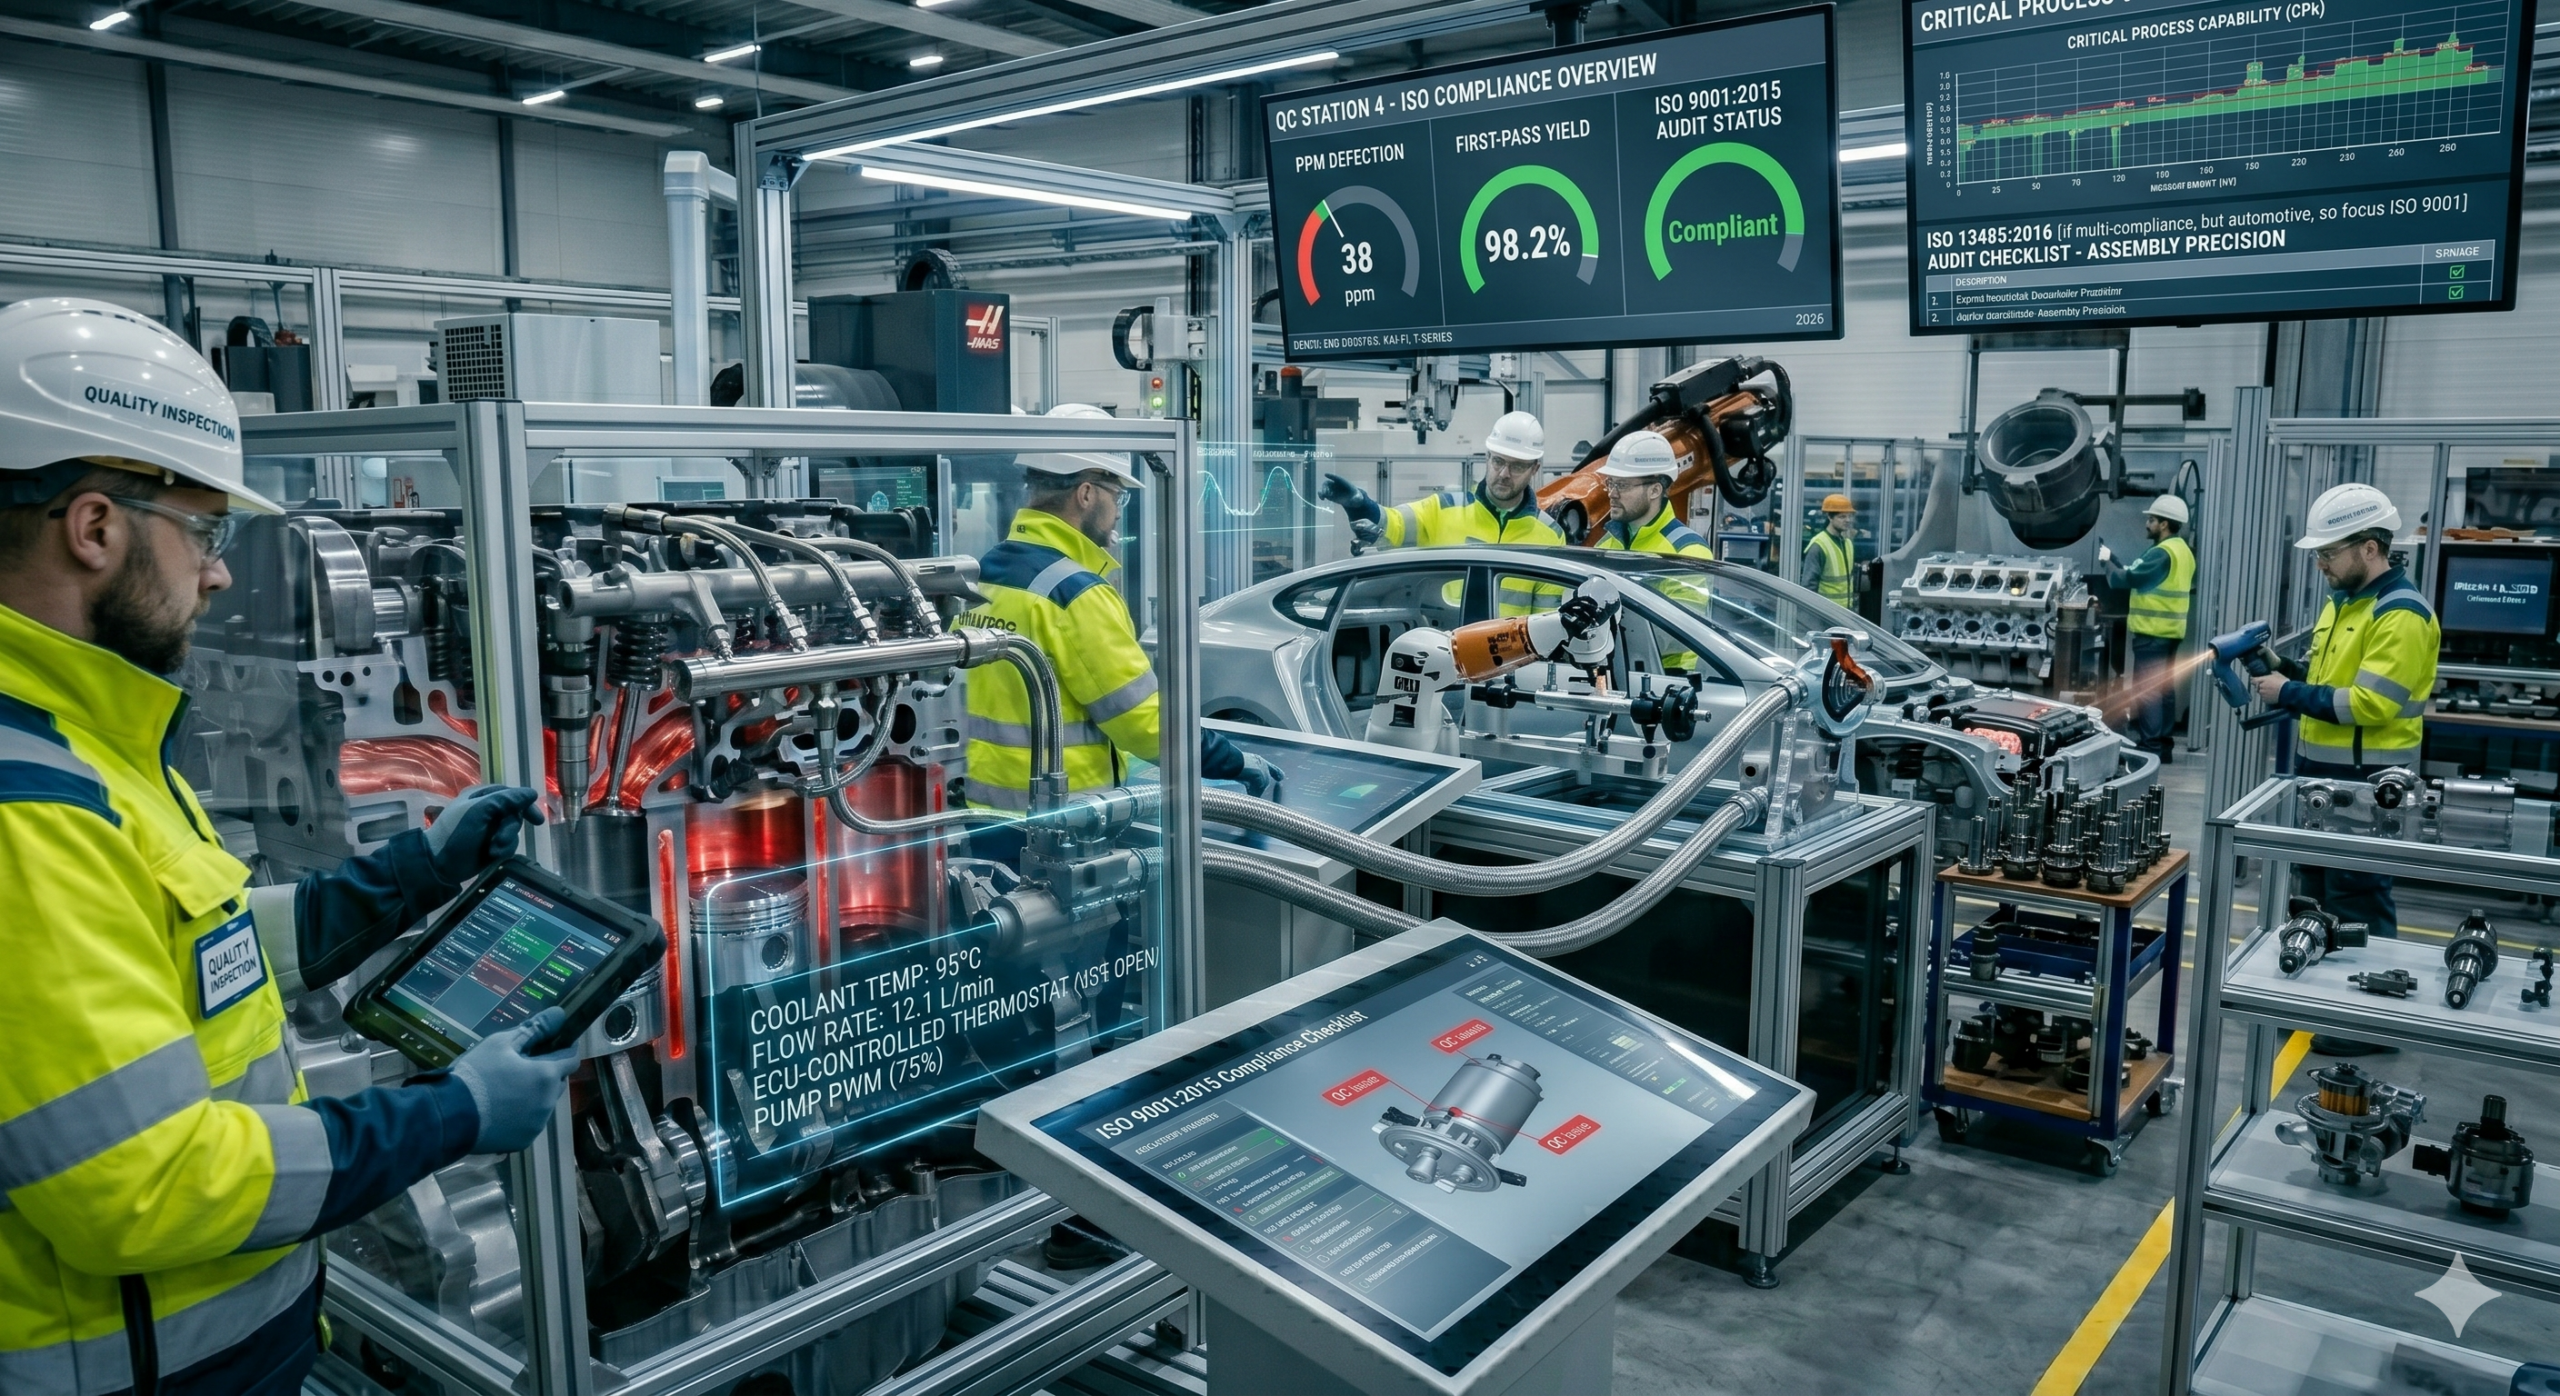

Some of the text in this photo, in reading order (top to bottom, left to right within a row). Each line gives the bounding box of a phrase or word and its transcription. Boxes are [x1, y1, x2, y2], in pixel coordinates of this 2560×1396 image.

[1920, 0, 2012, 32] CRITICAL
[2067, 30, 2128, 50] CRITICAL
[2131, 19, 2195, 42] PROCESS
[2199, 6, 2282, 32] CAPABILITY
[1276, 109, 1297, 132] QC
[1301, 95, 1370, 127] STATION
[1373, 95, 1385, 116] 4
[1401, 88, 1430, 112] ISO
[1434, 68, 1553, 108] COMPLIANCE
[1557, 53, 1658, 88] OVERVIEW
[1655, 79, 1782, 115] ISO 9001:2015
[1455, 119, 1591, 154] FIRST-PASS YIELD
[1656, 105, 1782, 140] AUDIT STATUS
[1295, 142, 1405, 173] PPM DEFECTION
[1668, 212, 1779, 247] Compliant
[1926, 231, 1954, 249] ISO
[1958, 223, 2052, 247] 13485:2016
[2075, 213, 2198, 239] multi-compliance,
[2201, 213, 2225, 230] but
[2228, 206, 2315, 228] automotive,
[2319, 206, 2338, 221] so
[2341, 202, 2385, 219] focus
[2389, 198, 2417, 216] ISO
[2421, 193, 2469, 213] 9001]
[1341, 241, 1373, 275] 38
[1483, 224, 1571, 264] 98.2%
[1927, 251, 1976, 271] AUDIT
[1979, 244, 2072, 267] CHECKLIST
[2087, 236, 2181, 261] ASSEMBLY
[2185, 229, 2286, 254] PRECISION
[1344, 285, 1376, 307] ppm
[1795, 312, 1825, 327] 2026
[161, 404, 235, 443] INSPECTION
[208, 937, 250, 977] QUALITY
[750, 982, 859, 1036] COOLANT
[865, 963, 930, 1001] TEMP:
[752, 975, 995, 1069] FLOW RATE: 12.1 L/min
[753, 1017, 946, 1101] ECU-CONTROLLED
[950, 975, 1070, 1034] THERMOSTAT
[1114, 946, 1159, 979] OPEN)
[754, 1046, 944, 1134] PUMP PWM (75%)
[1095, 1116, 1135, 1141] ISO
[1130, 1076, 1223, 1123] 9001:2015
[1217, 1039, 1307, 1084] Compliance
[1300, 1009, 1370, 1045] Checklist
